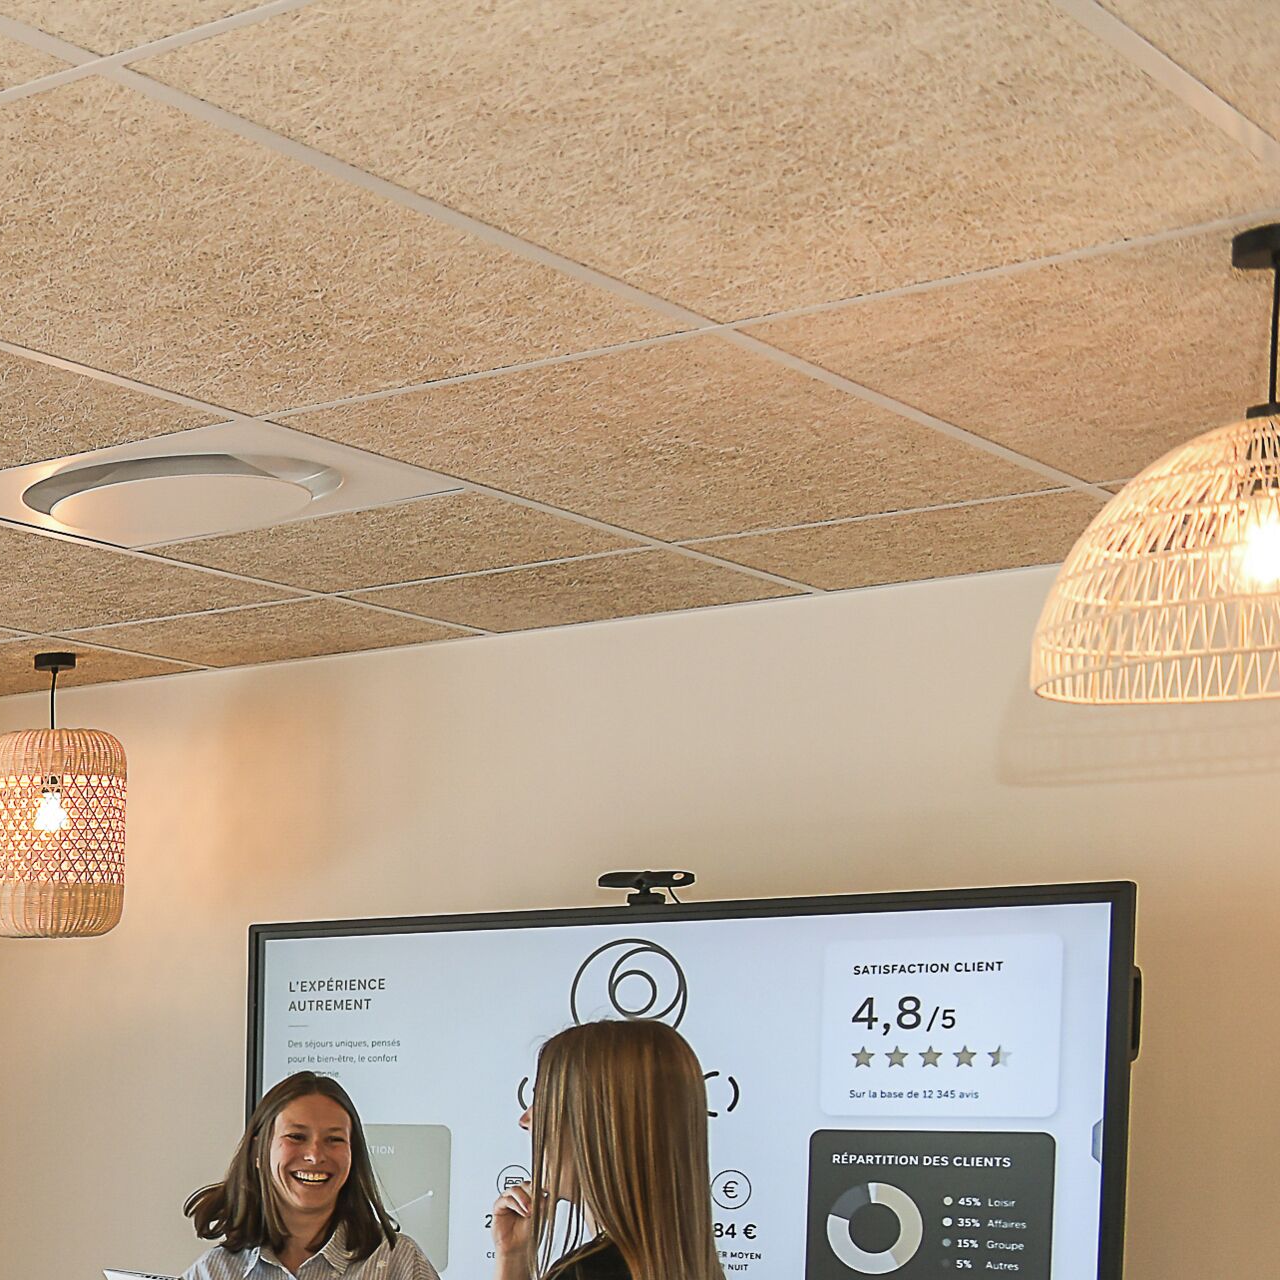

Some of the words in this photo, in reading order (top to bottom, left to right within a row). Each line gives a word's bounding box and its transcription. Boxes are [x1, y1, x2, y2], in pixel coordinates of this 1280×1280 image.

[853, 963, 950, 976] SATISFACTION
[954, 961, 1004, 973] CLIENT
[289, 977, 386, 992] L'EXPÉRIENCE
[288, 998, 372, 1012] AUTREMENT
[851, 996, 956, 1036] 4,8/5
[287, 1039, 303, 1048] Des
[304, 1039, 333, 1049] séjours
[335, 1039, 369, 1048] uniques,
[371, 1038, 401, 1048] pensés
[287, 1056, 307, 1064] pour
[307, 1055, 315, 1063] le
[317, 1054, 356, 1063] bien-être,
[358, 1054, 366, 1063] le
[367, 1053, 398, 1063] confort
[849, 1089, 866, 1099] Sur
[868, 1090, 878, 1099] la
[880, 1089, 904, 1099] base
[906, 1089, 920, 1099] de
[923, 1089, 934, 1099] 12
[936, 1089, 956, 1099] 345
[958, 1090, 980, 1099] avis
[832, 1152, 919, 1166] RÉPARTITION
[923, 1156, 949, 1167] DES
[953, 1157, 1012, 1168] CLIENTS
[958, 1197, 982, 1207] 45%
[987, 1198, 1016, 1207] Loisir
[957, 1217, 981, 1228] 35%
[987, 1219, 1027, 1229] Affaires
[743, 1223, 757, 1240] €
[956, 1239, 979, 1249] 15%
[986, 1240, 1025, 1251] Groupe
[730, 1251, 762, 1260] MOYEN
[727, 1263, 748, 1271] NUIT
[956, 1259, 973, 1269] 5%
[985, 1261, 1019, 1271] Autres
